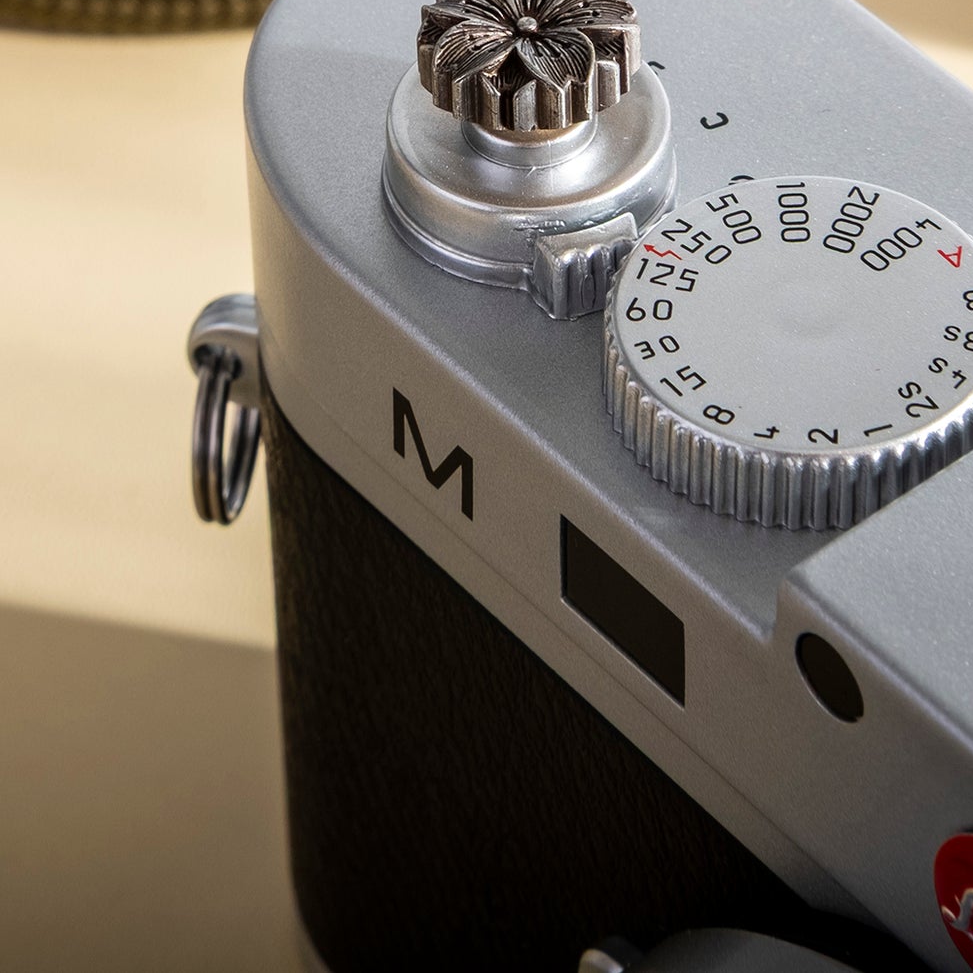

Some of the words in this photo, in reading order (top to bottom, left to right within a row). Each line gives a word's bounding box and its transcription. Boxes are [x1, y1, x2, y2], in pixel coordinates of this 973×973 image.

[699, 112, 729, 130] C
[705, 193, 762, 245] 500
[776, 181, 811, 244] 1000
[822, 185, 880, 255] 2000
[661, 218, 733, 266] 250
[860, 217, 942, 273] 4000
[937, 245, 963, 268] A
[635, 256, 700, 293] 125
[625, 296, 674, 322] 60
[633, 334, 681, 361] 30
[659, 365, 708, 398] 15
[702, 403, 736, 426] 8
[753, 425, 781, 441] 4
[807, 427, 840, 445] 2
[863, 423, 894, 438] 1
[392, 386, 474, 522] M
